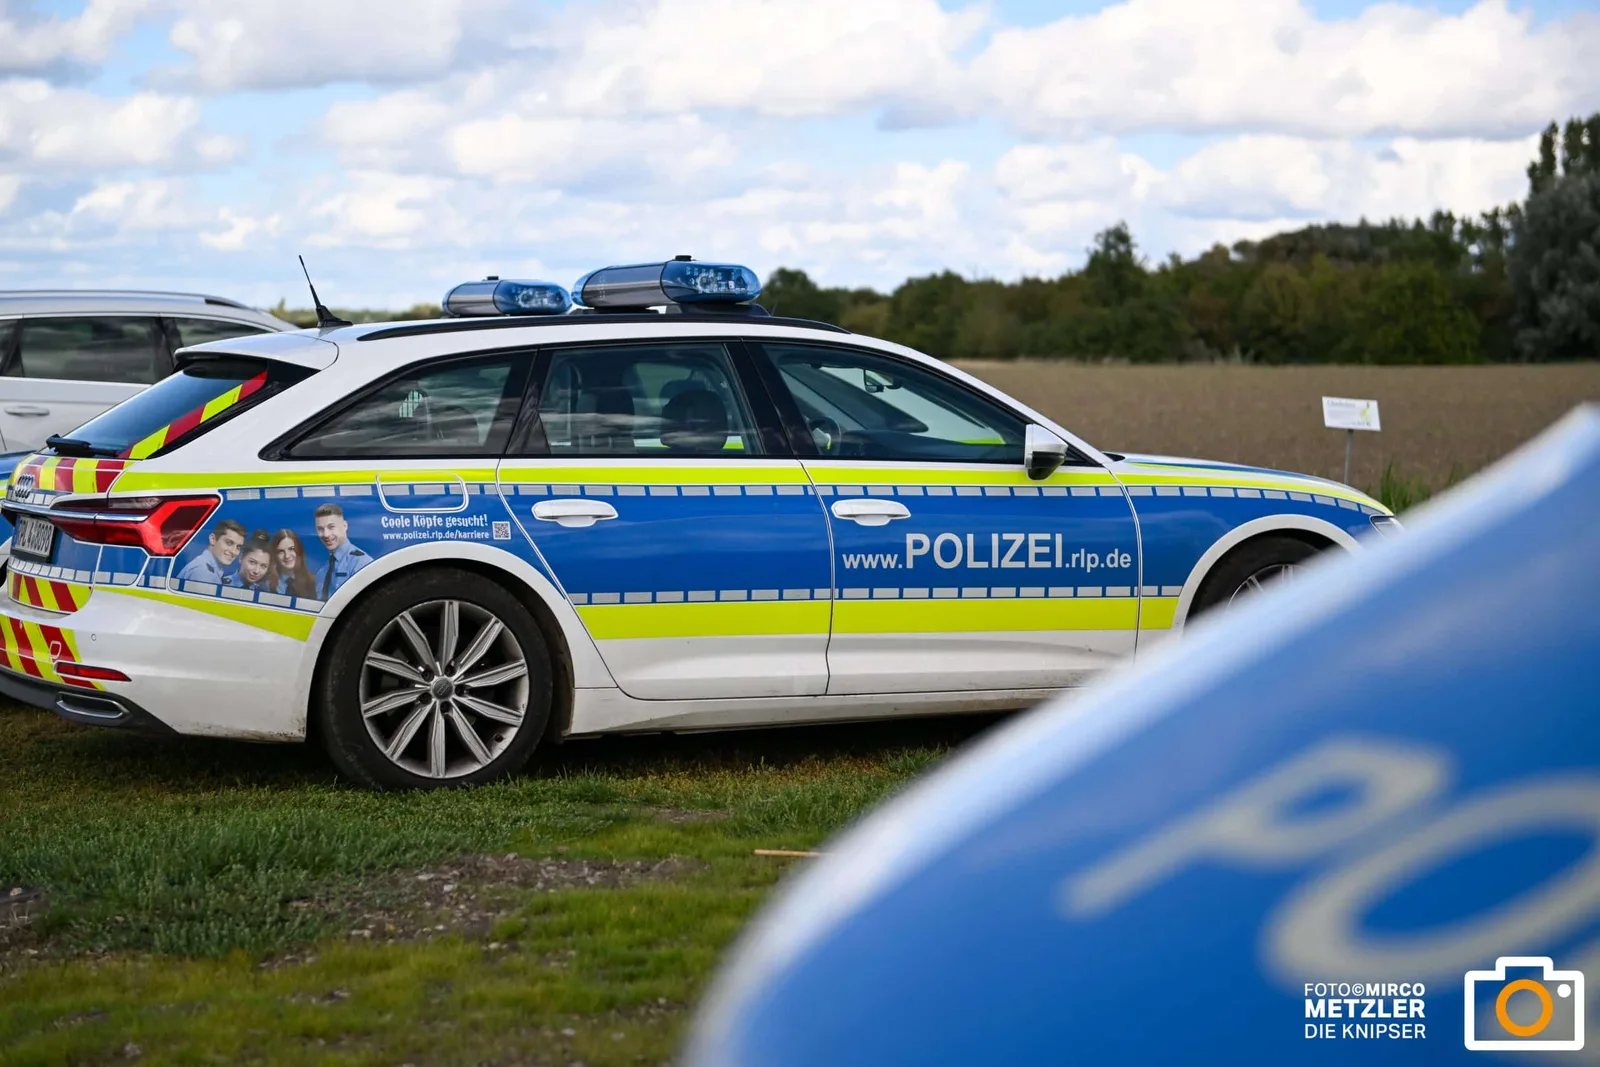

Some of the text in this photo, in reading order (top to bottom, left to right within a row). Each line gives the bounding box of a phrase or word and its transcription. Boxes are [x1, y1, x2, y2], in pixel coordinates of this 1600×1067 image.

[381, 514, 488, 528] Coole Köpfe gesucht!
[382, 529, 489, 541] www.polizei.rlp.de/karriere
[842, 533, 1132, 573] www.POLIZEI.rlp.de
